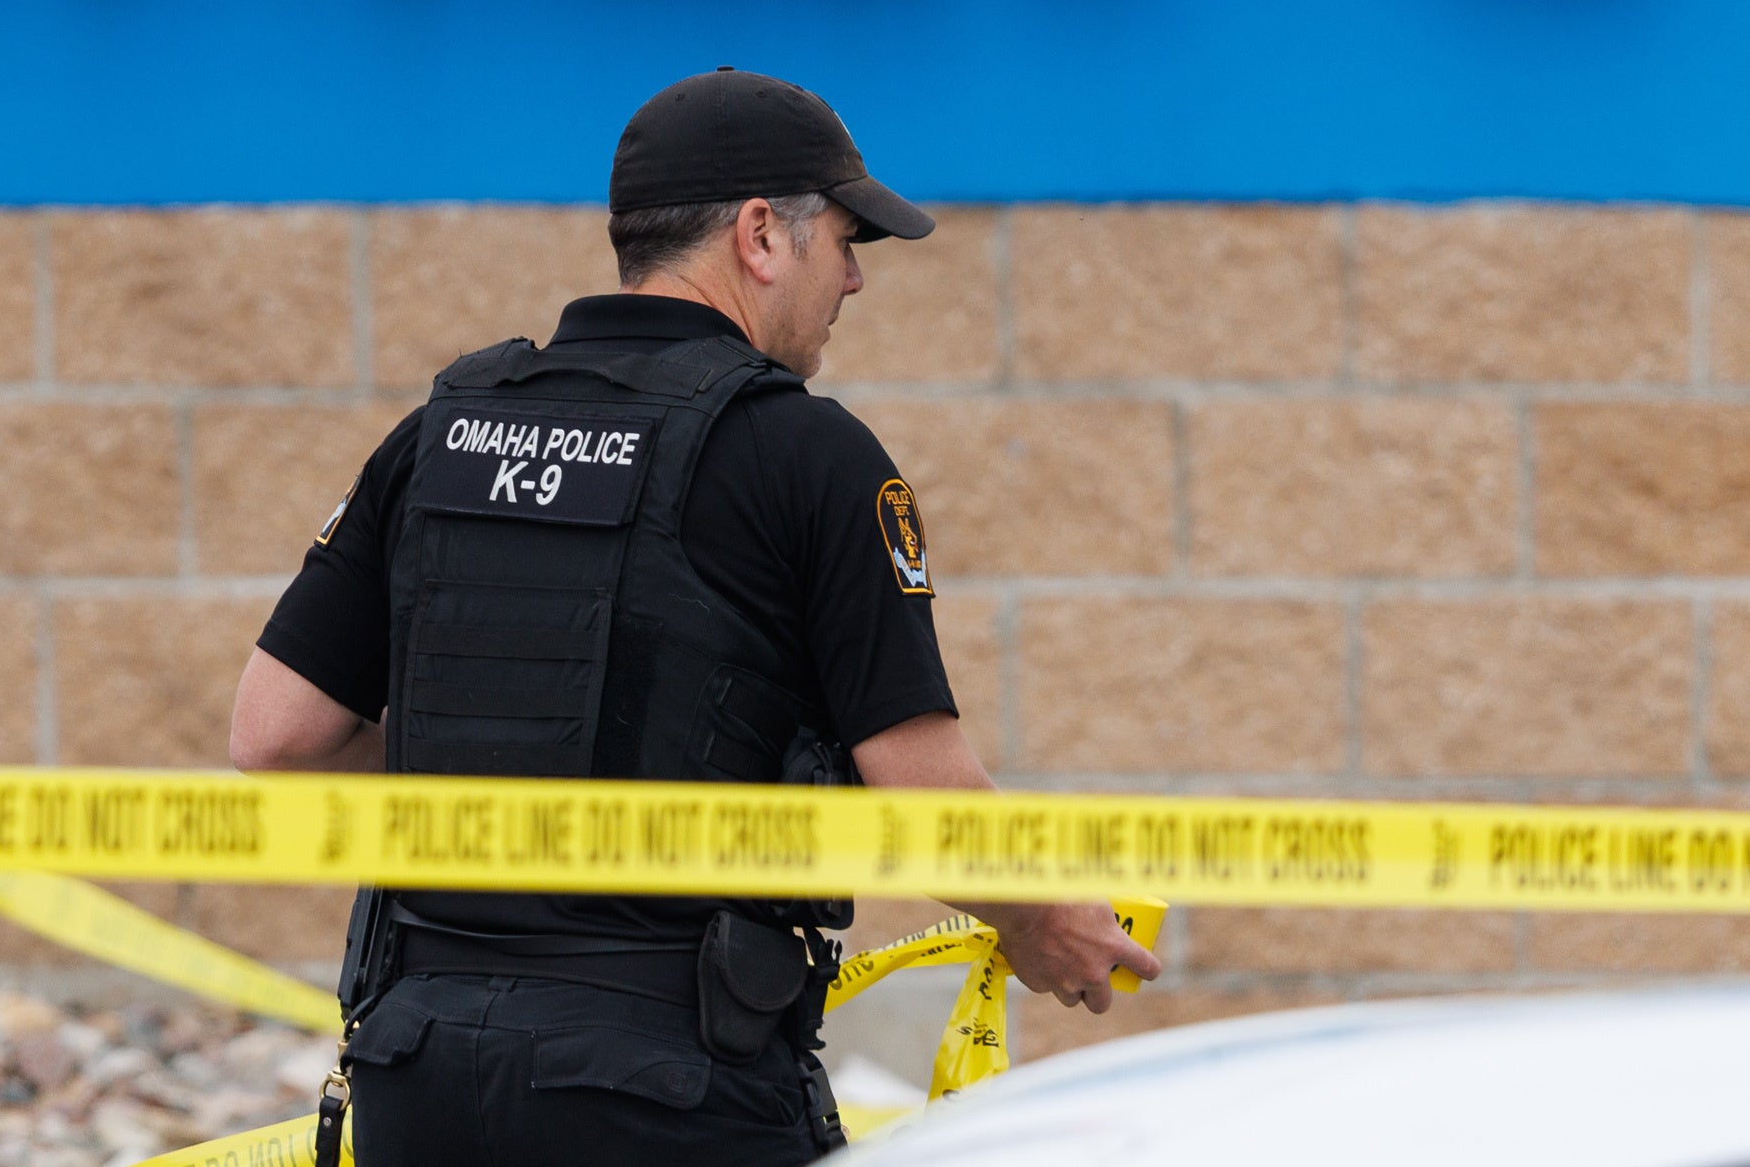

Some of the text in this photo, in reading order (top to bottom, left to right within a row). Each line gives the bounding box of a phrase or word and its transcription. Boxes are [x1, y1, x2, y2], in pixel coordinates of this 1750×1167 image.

[446, 418, 640, 465] OMAHA POLICE
[489, 459, 563, 505] K-9
[884, 490, 911, 505] POLICE
[28, 782, 69, 853] DO
[82, 783, 148, 855] NOT
[157, 784, 267, 858] CROSS
[380, 791, 824, 871] POLICE LINE DO NOT CROSS
[935, 806, 1373, 885] POLICE LINE DO NOT CROSS
[1489, 823, 1598, 892] POLICE
[1607, 825, 1678, 894] LINE
[1687, 826, 1736, 894] DO
